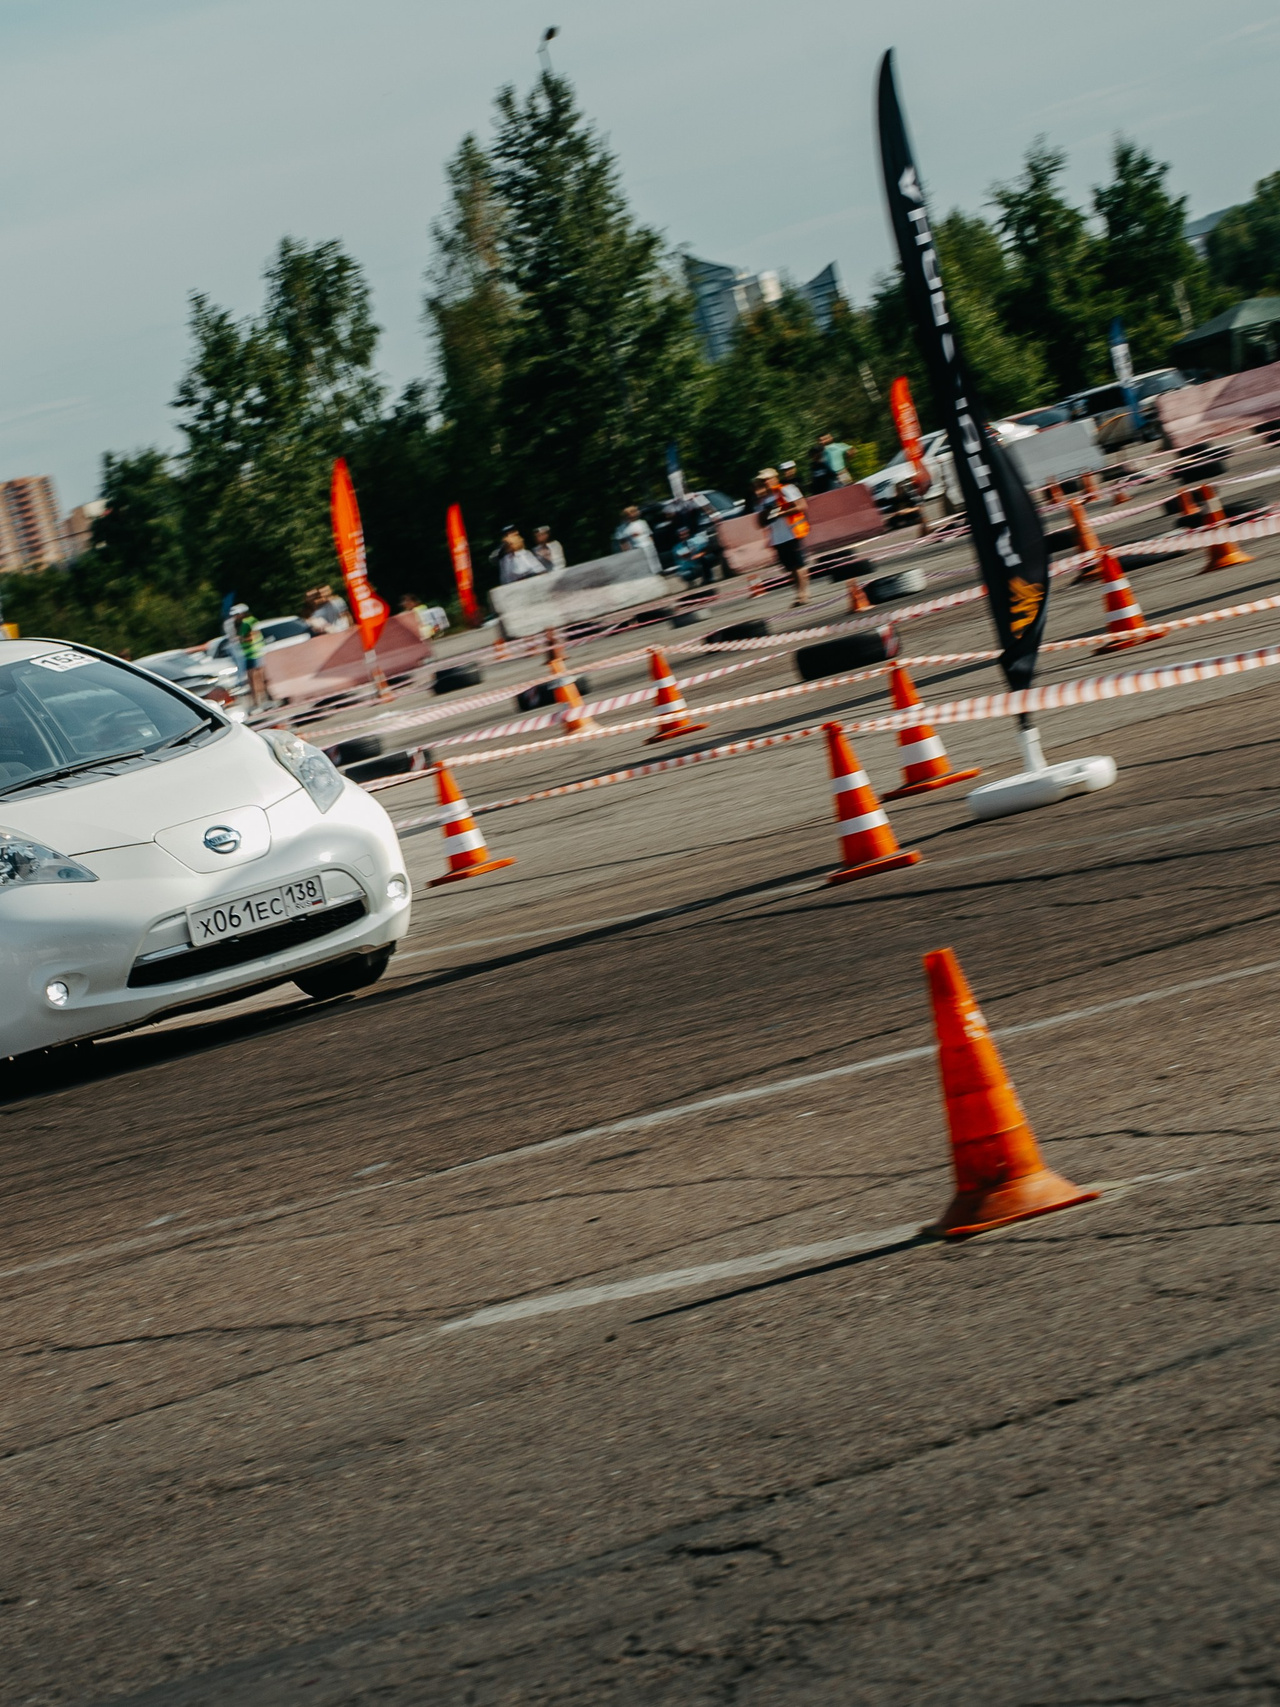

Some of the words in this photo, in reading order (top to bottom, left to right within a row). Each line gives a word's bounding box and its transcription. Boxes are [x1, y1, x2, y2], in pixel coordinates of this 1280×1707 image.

[41, 653, 85, 666] 153
[285, 880, 318, 903] 138
[295, 900, 313, 910] RUS
